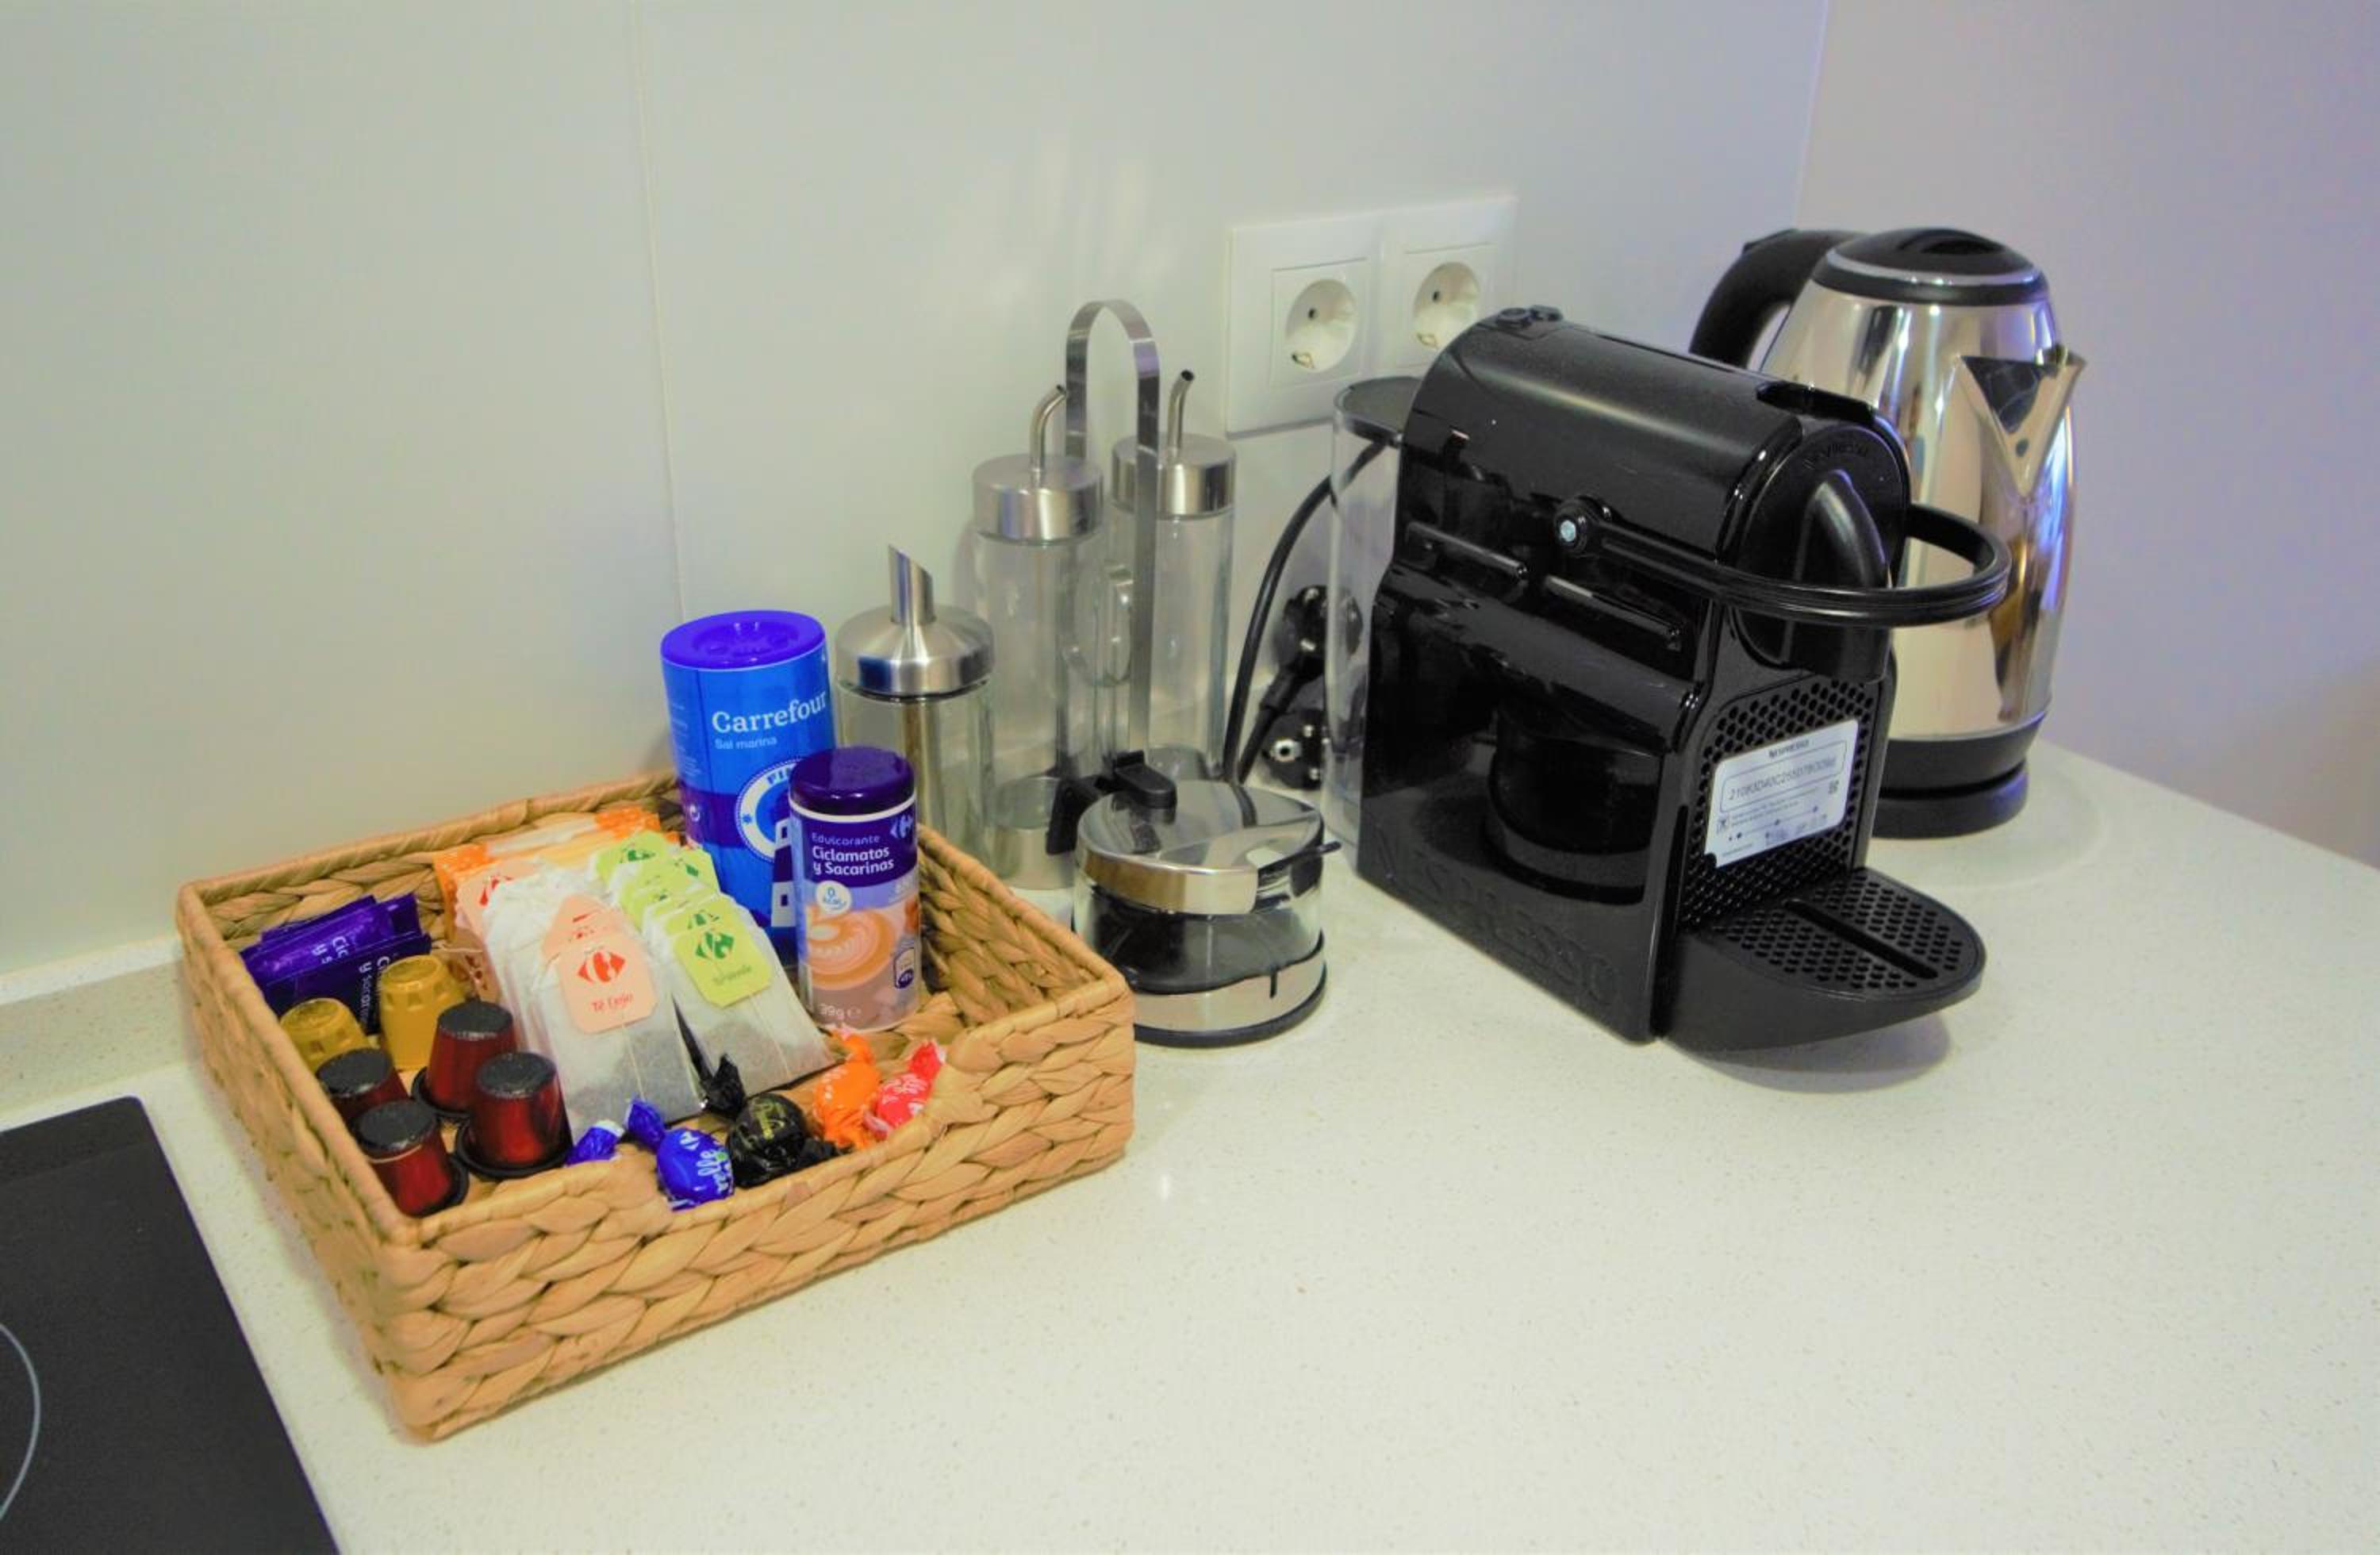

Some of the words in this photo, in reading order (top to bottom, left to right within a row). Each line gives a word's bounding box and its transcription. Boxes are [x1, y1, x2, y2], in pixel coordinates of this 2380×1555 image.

[712, 691, 826, 734] Carrefour
[715, 738, 733, 750] Sal
[736, 737, 777, 750] marina
[812, 832, 881, 847] Edulcorante
[812, 845, 890, 862] Ciclamatos
[813, 862, 822, 875] y
[824, 858, 895, 876] Sacarinas
